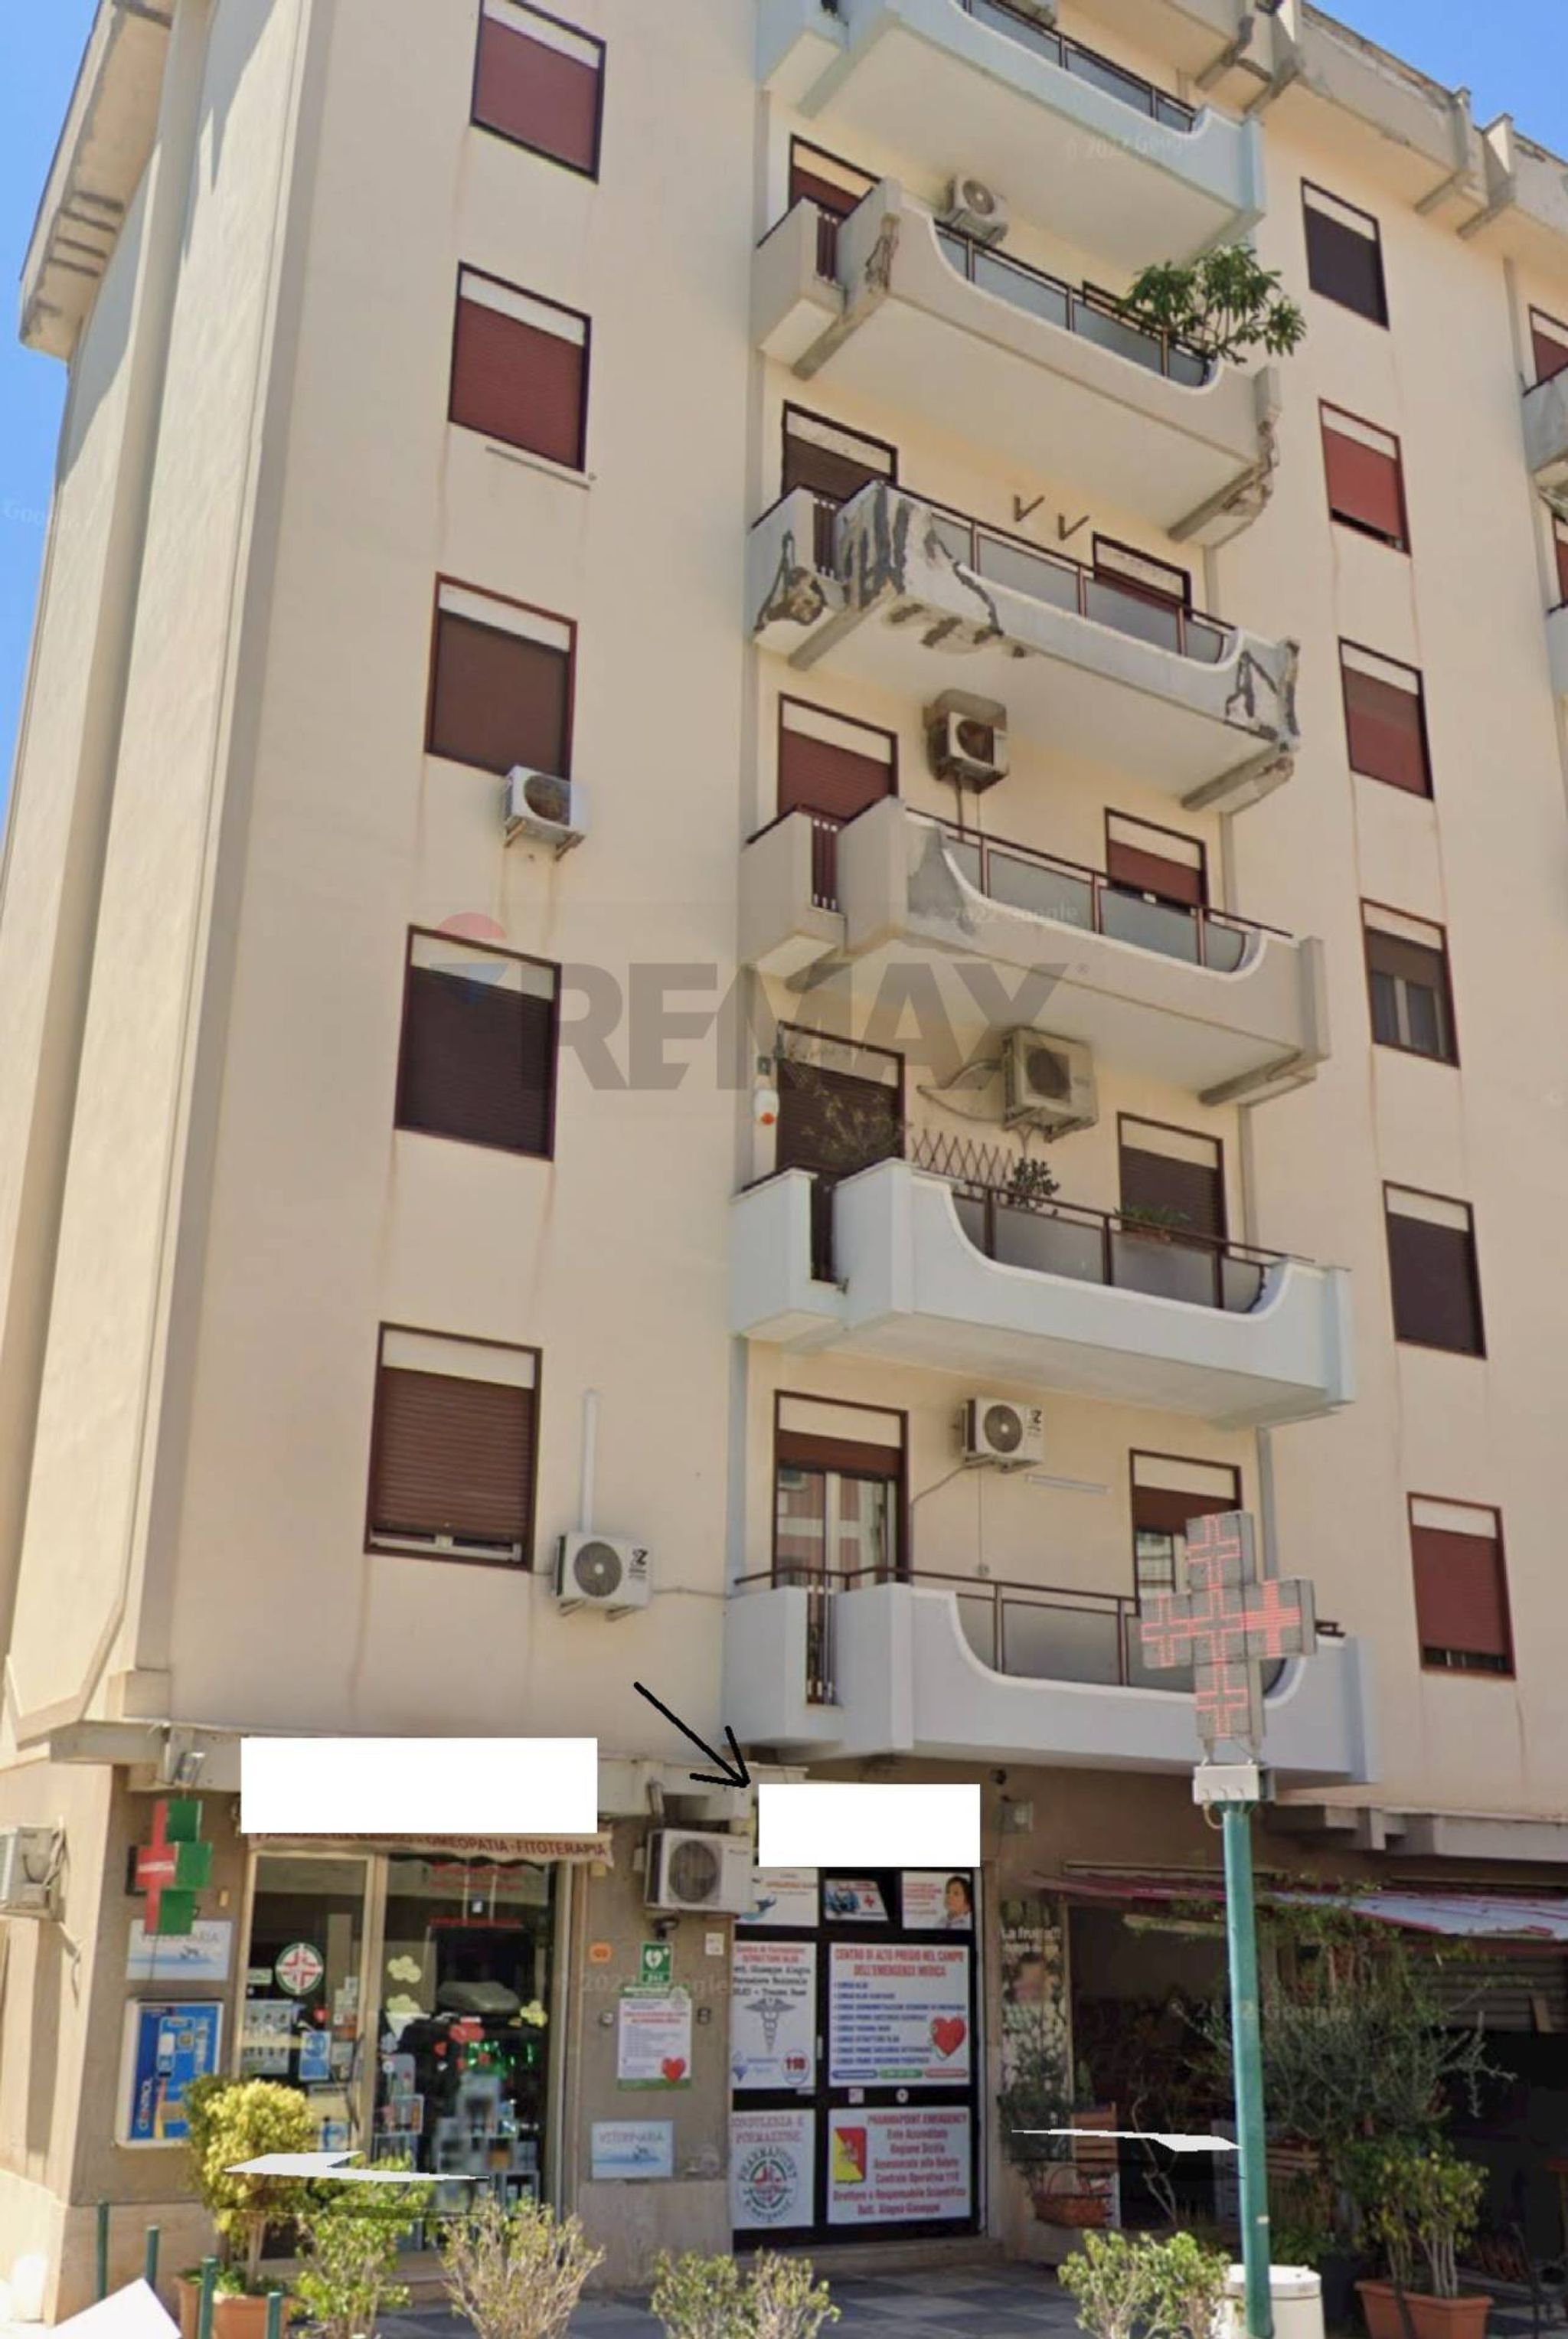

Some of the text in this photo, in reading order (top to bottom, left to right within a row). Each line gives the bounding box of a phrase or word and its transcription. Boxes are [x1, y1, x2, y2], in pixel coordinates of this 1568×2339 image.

[516, 1838, 606, 1857] FITOTERAPIA
[835, 1948, 864, 1961] CENTRO
[876, 1948, 893, 1961] ALTO
[923, 1949, 936, 1962] NEL
[786, 2056, 806, 2070] 118
